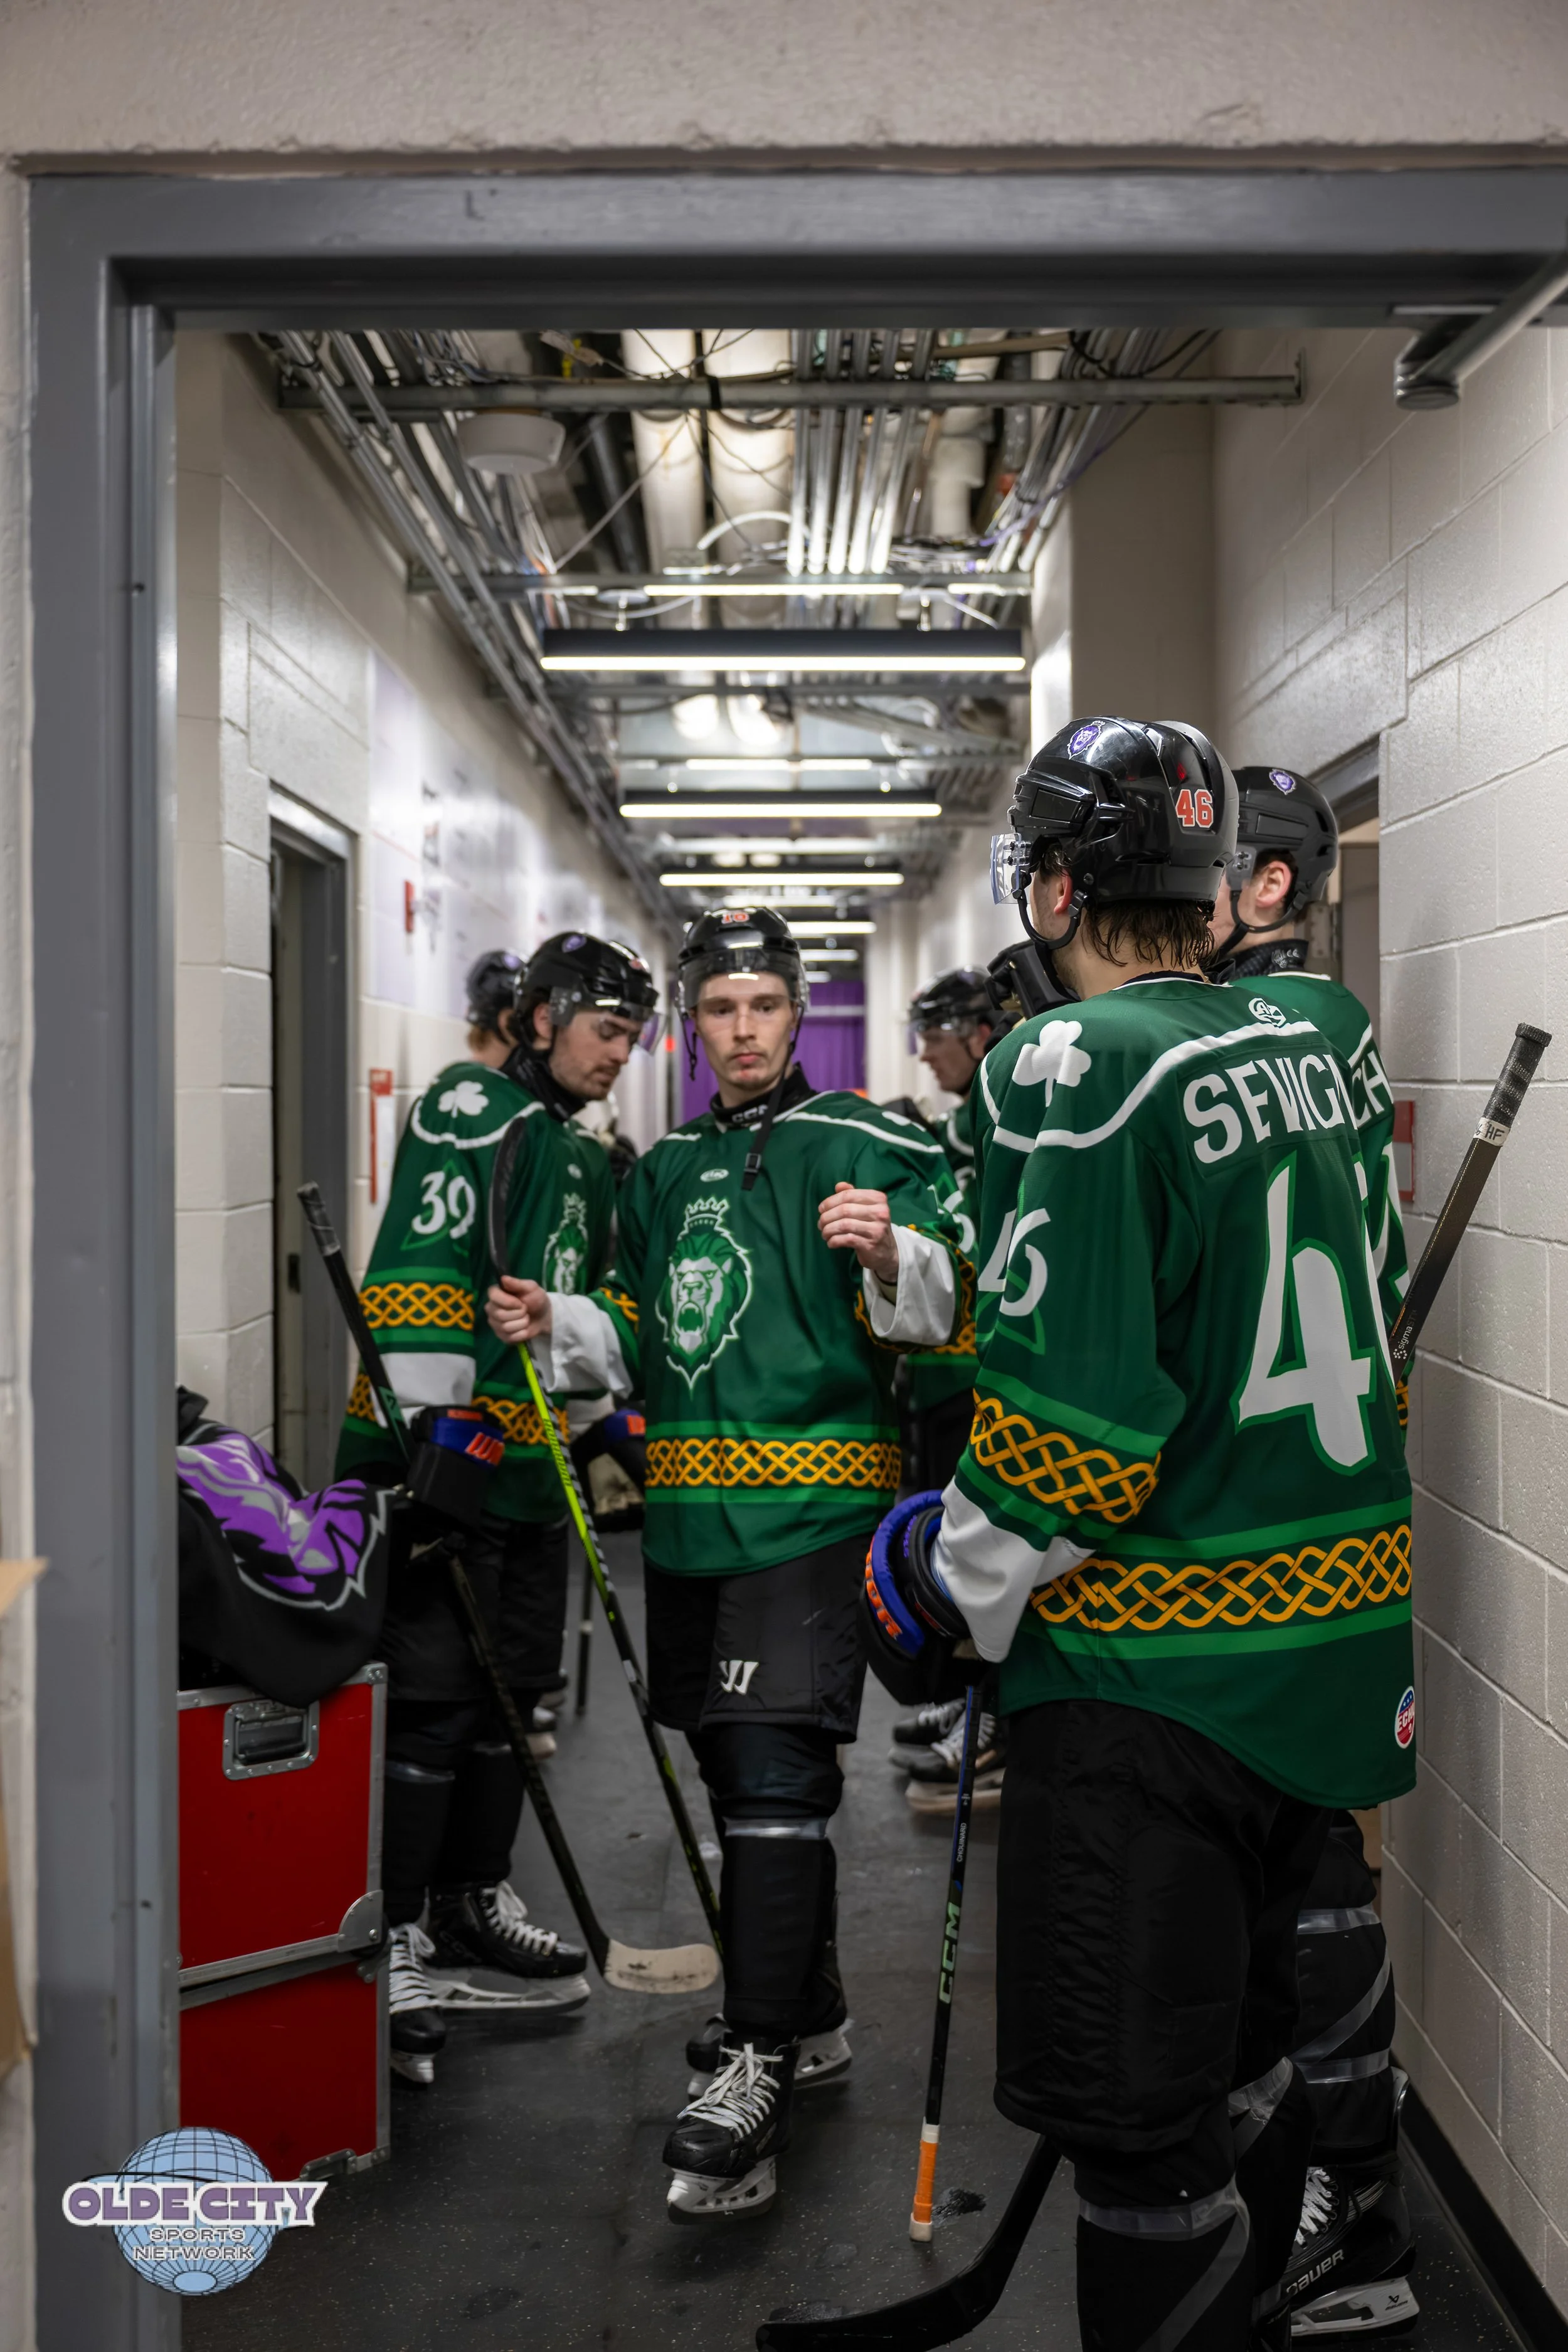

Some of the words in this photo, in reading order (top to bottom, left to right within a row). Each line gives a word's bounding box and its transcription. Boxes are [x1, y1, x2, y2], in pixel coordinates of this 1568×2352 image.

[1175, 789, 1214, 828] 46
[1485, 1123, 1505, 1140] HF
[411, 1170, 476, 1239] 39
[977, 1208, 1051, 1316] 46
[1238, 1149, 1395, 1466] 4
[956, 1822, 967, 1863] CHOUINARD
[939, 1902, 960, 2005] CCM
